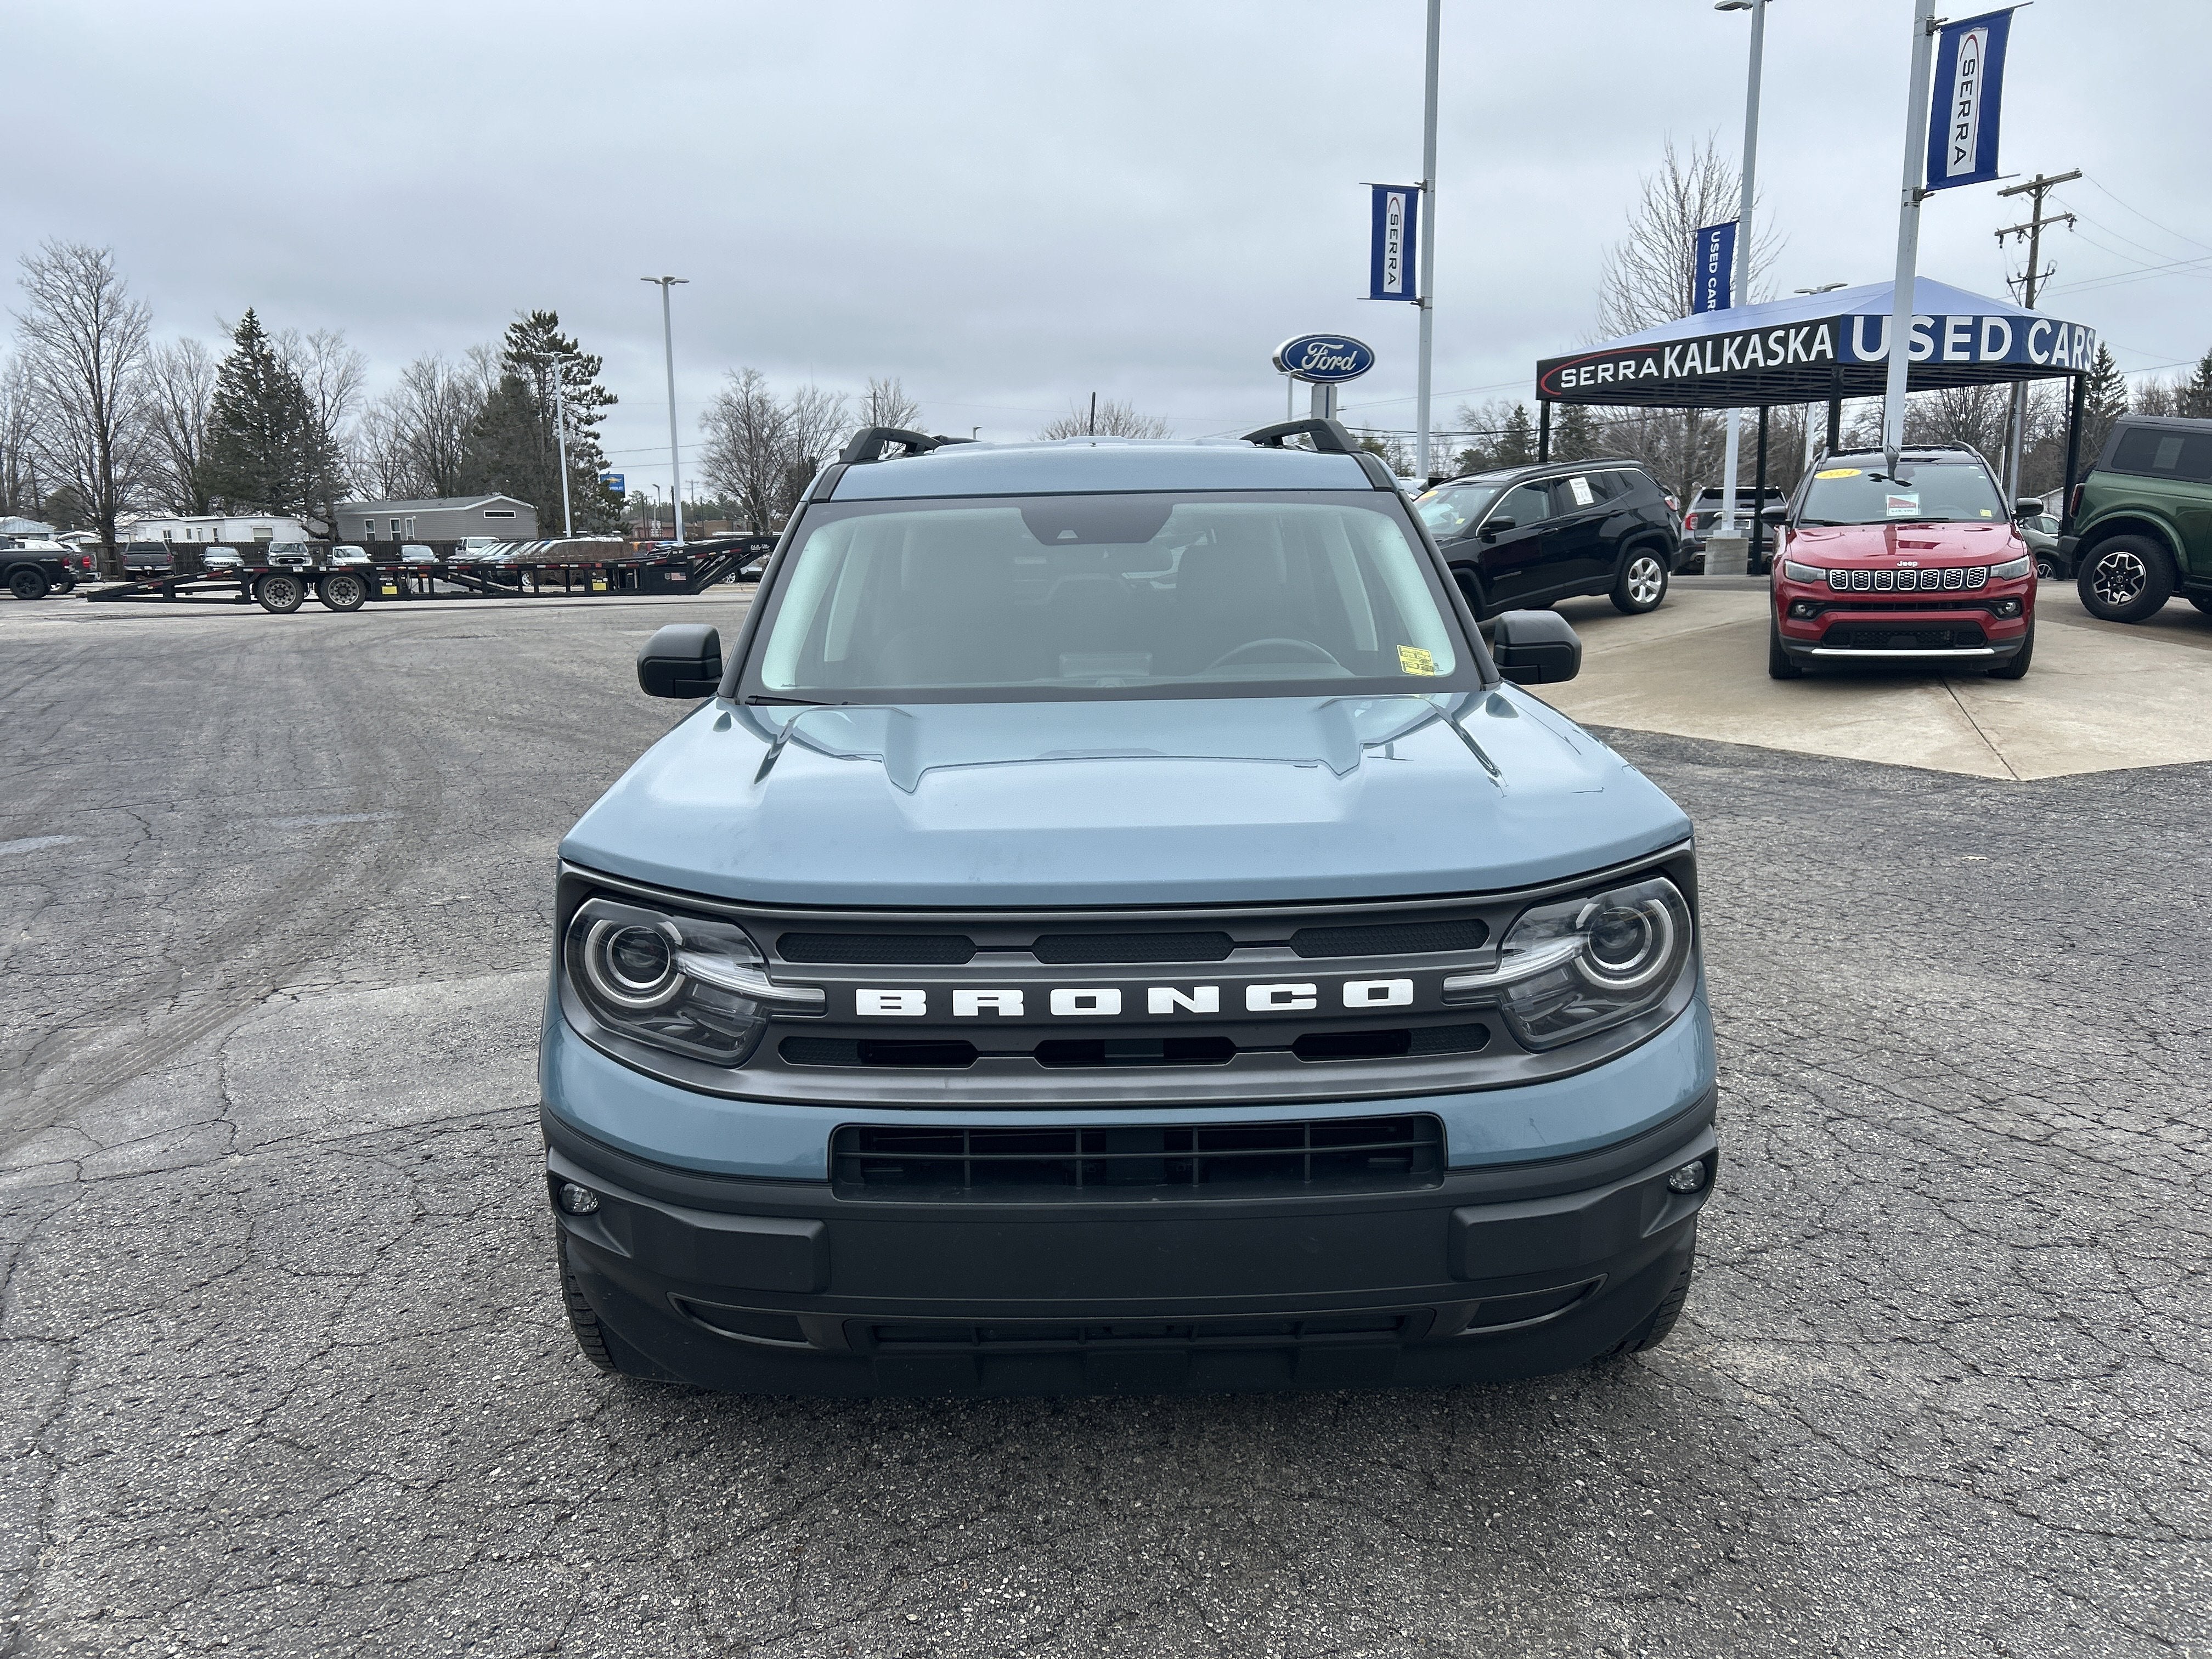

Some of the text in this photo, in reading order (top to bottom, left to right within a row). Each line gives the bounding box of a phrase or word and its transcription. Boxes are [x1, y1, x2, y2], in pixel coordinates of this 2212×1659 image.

[1954, 58, 1976, 166] SERRA
[1387, 213, 1398, 285] SERRA
[1707, 230, 1720, 312] USED CAR
[1301, 342, 1358, 371] Ford
[1560, 323, 1834, 388] SERRA KALKASKA
[1851, 315, 2097, 373] USED CARS
[855, 978, 1414, 1017] BRONCO
